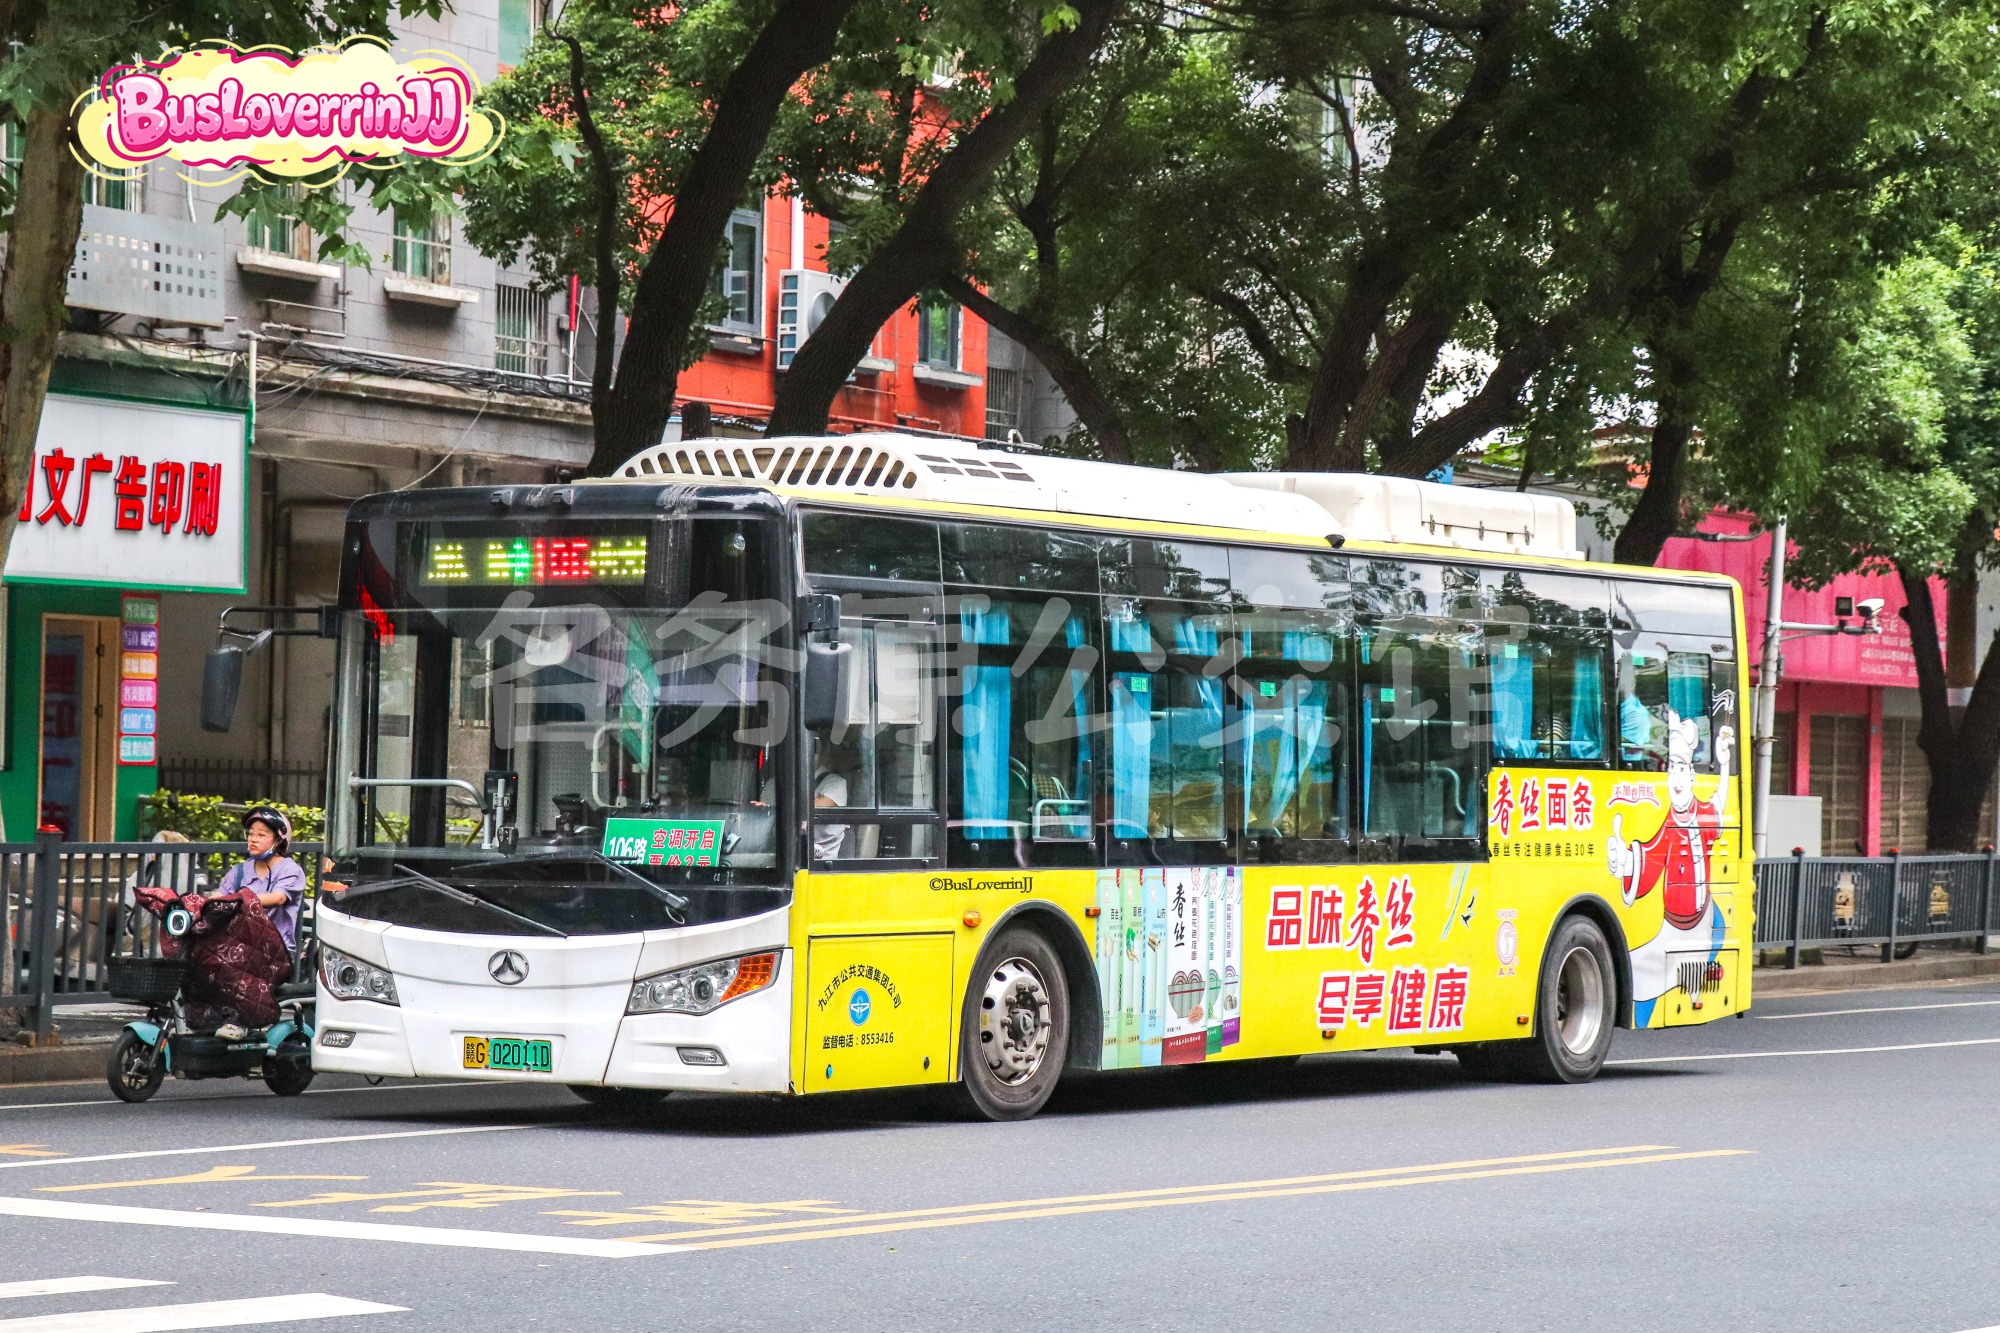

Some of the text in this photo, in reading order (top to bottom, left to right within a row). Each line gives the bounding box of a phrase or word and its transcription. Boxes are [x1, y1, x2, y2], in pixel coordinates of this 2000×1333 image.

[18, 447, 222, 536] 文广告印刷
[1490, 774, 1593, 836] 春丝面条
[651, 828, 716, 849] 空调开启
[1493, 842, 1595, 858] 春丝专注健康食品30年
[1171, 882, 1187, 948] 春丝
[1267, 878, 1414, 964] 品味春丝
[818, 963, 902, 1012] 九江市公共交通集团公司
[1317, 968, 1468, 1031] 尽享健康
